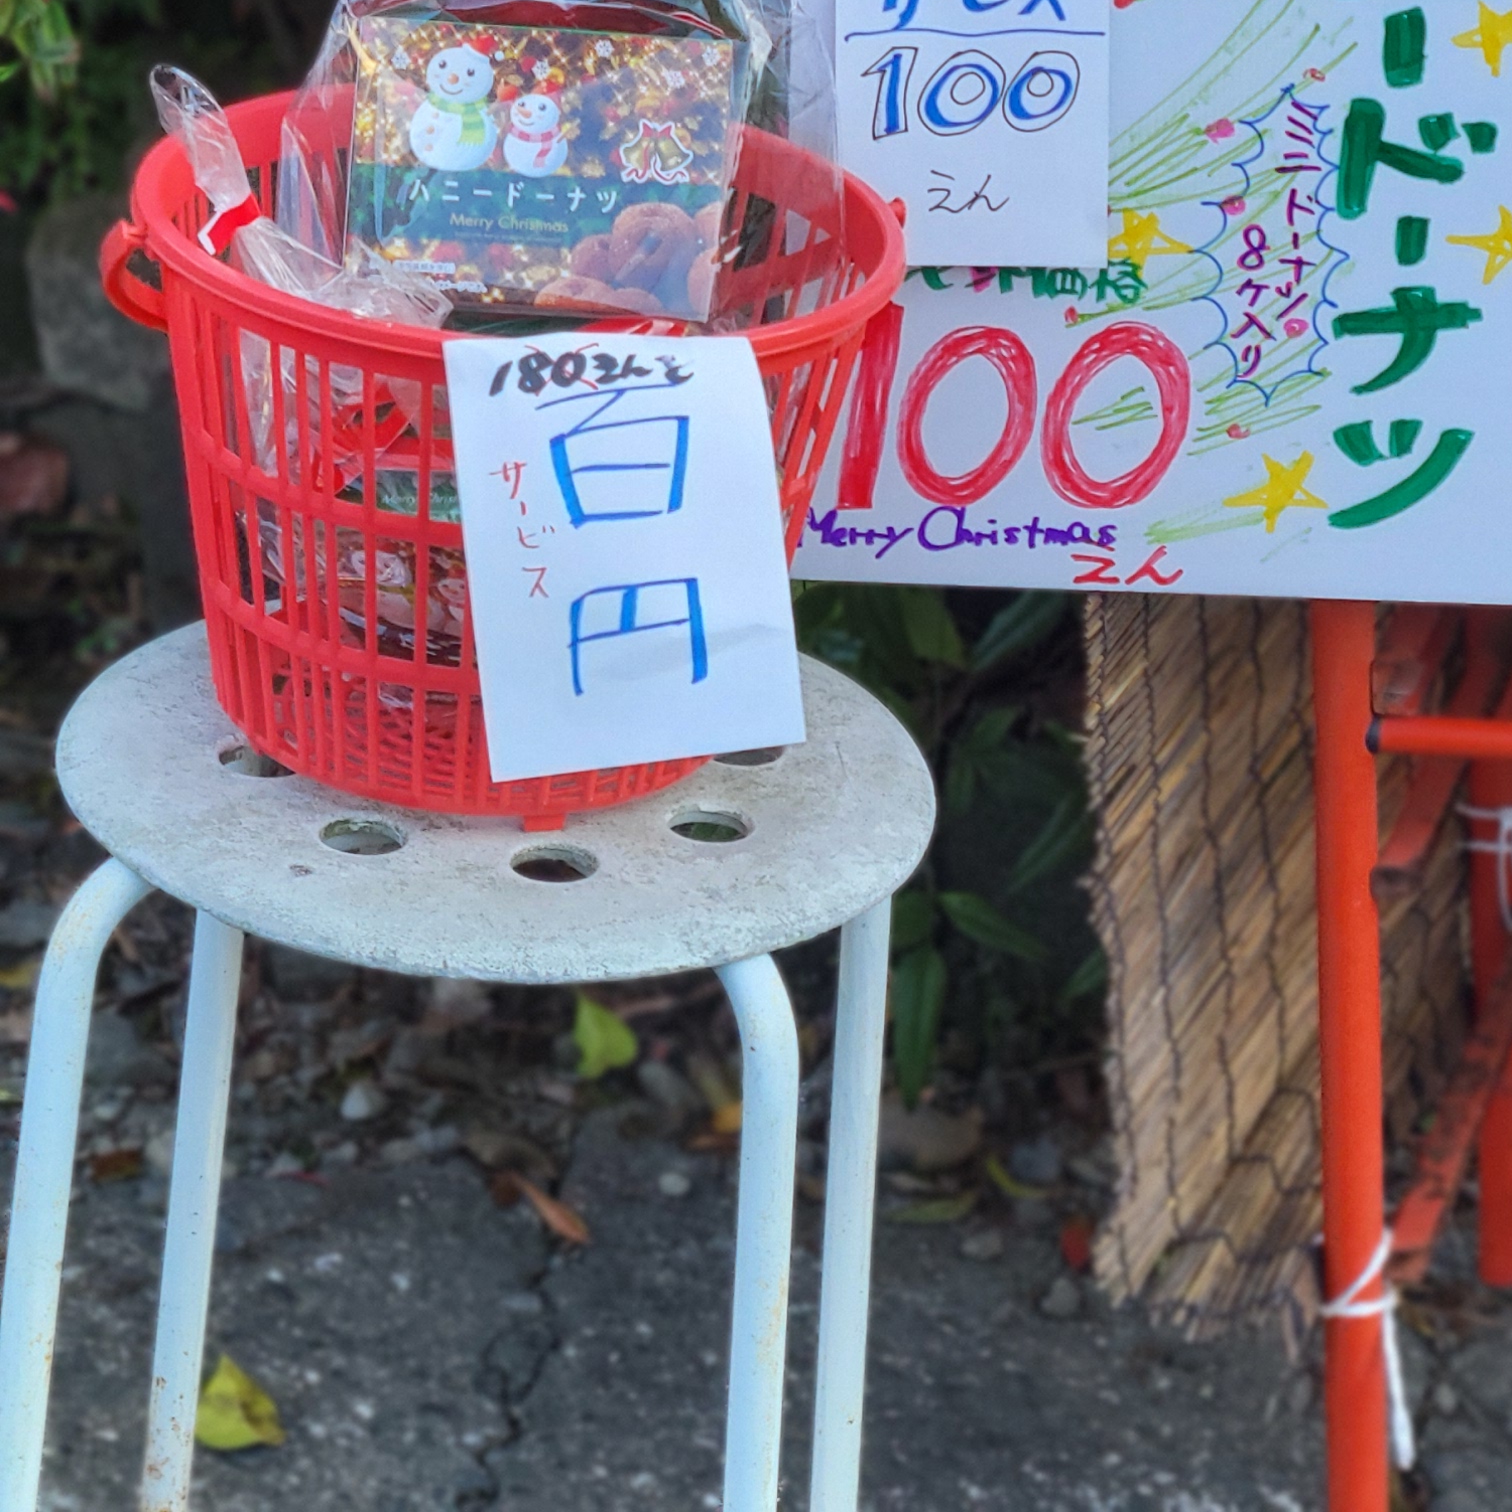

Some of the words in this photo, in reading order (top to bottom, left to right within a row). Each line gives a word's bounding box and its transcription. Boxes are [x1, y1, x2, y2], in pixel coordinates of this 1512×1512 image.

[860, 46, 1081, 141] 100
[409, 179, 618, 214] ハニードーナツ
[926, 169, 1011, 214] えん
[450, 213, 494, 229] Merry
[497, 215, 569, 233] Christmas
[834, 303, 1192, 511] 100
[489, 460, 556, 599] サービス
[533, 382, 708, 696] 百円
[917, 505, 1118, 552] Christmas
[1070, 540, 1184, 586] えん
